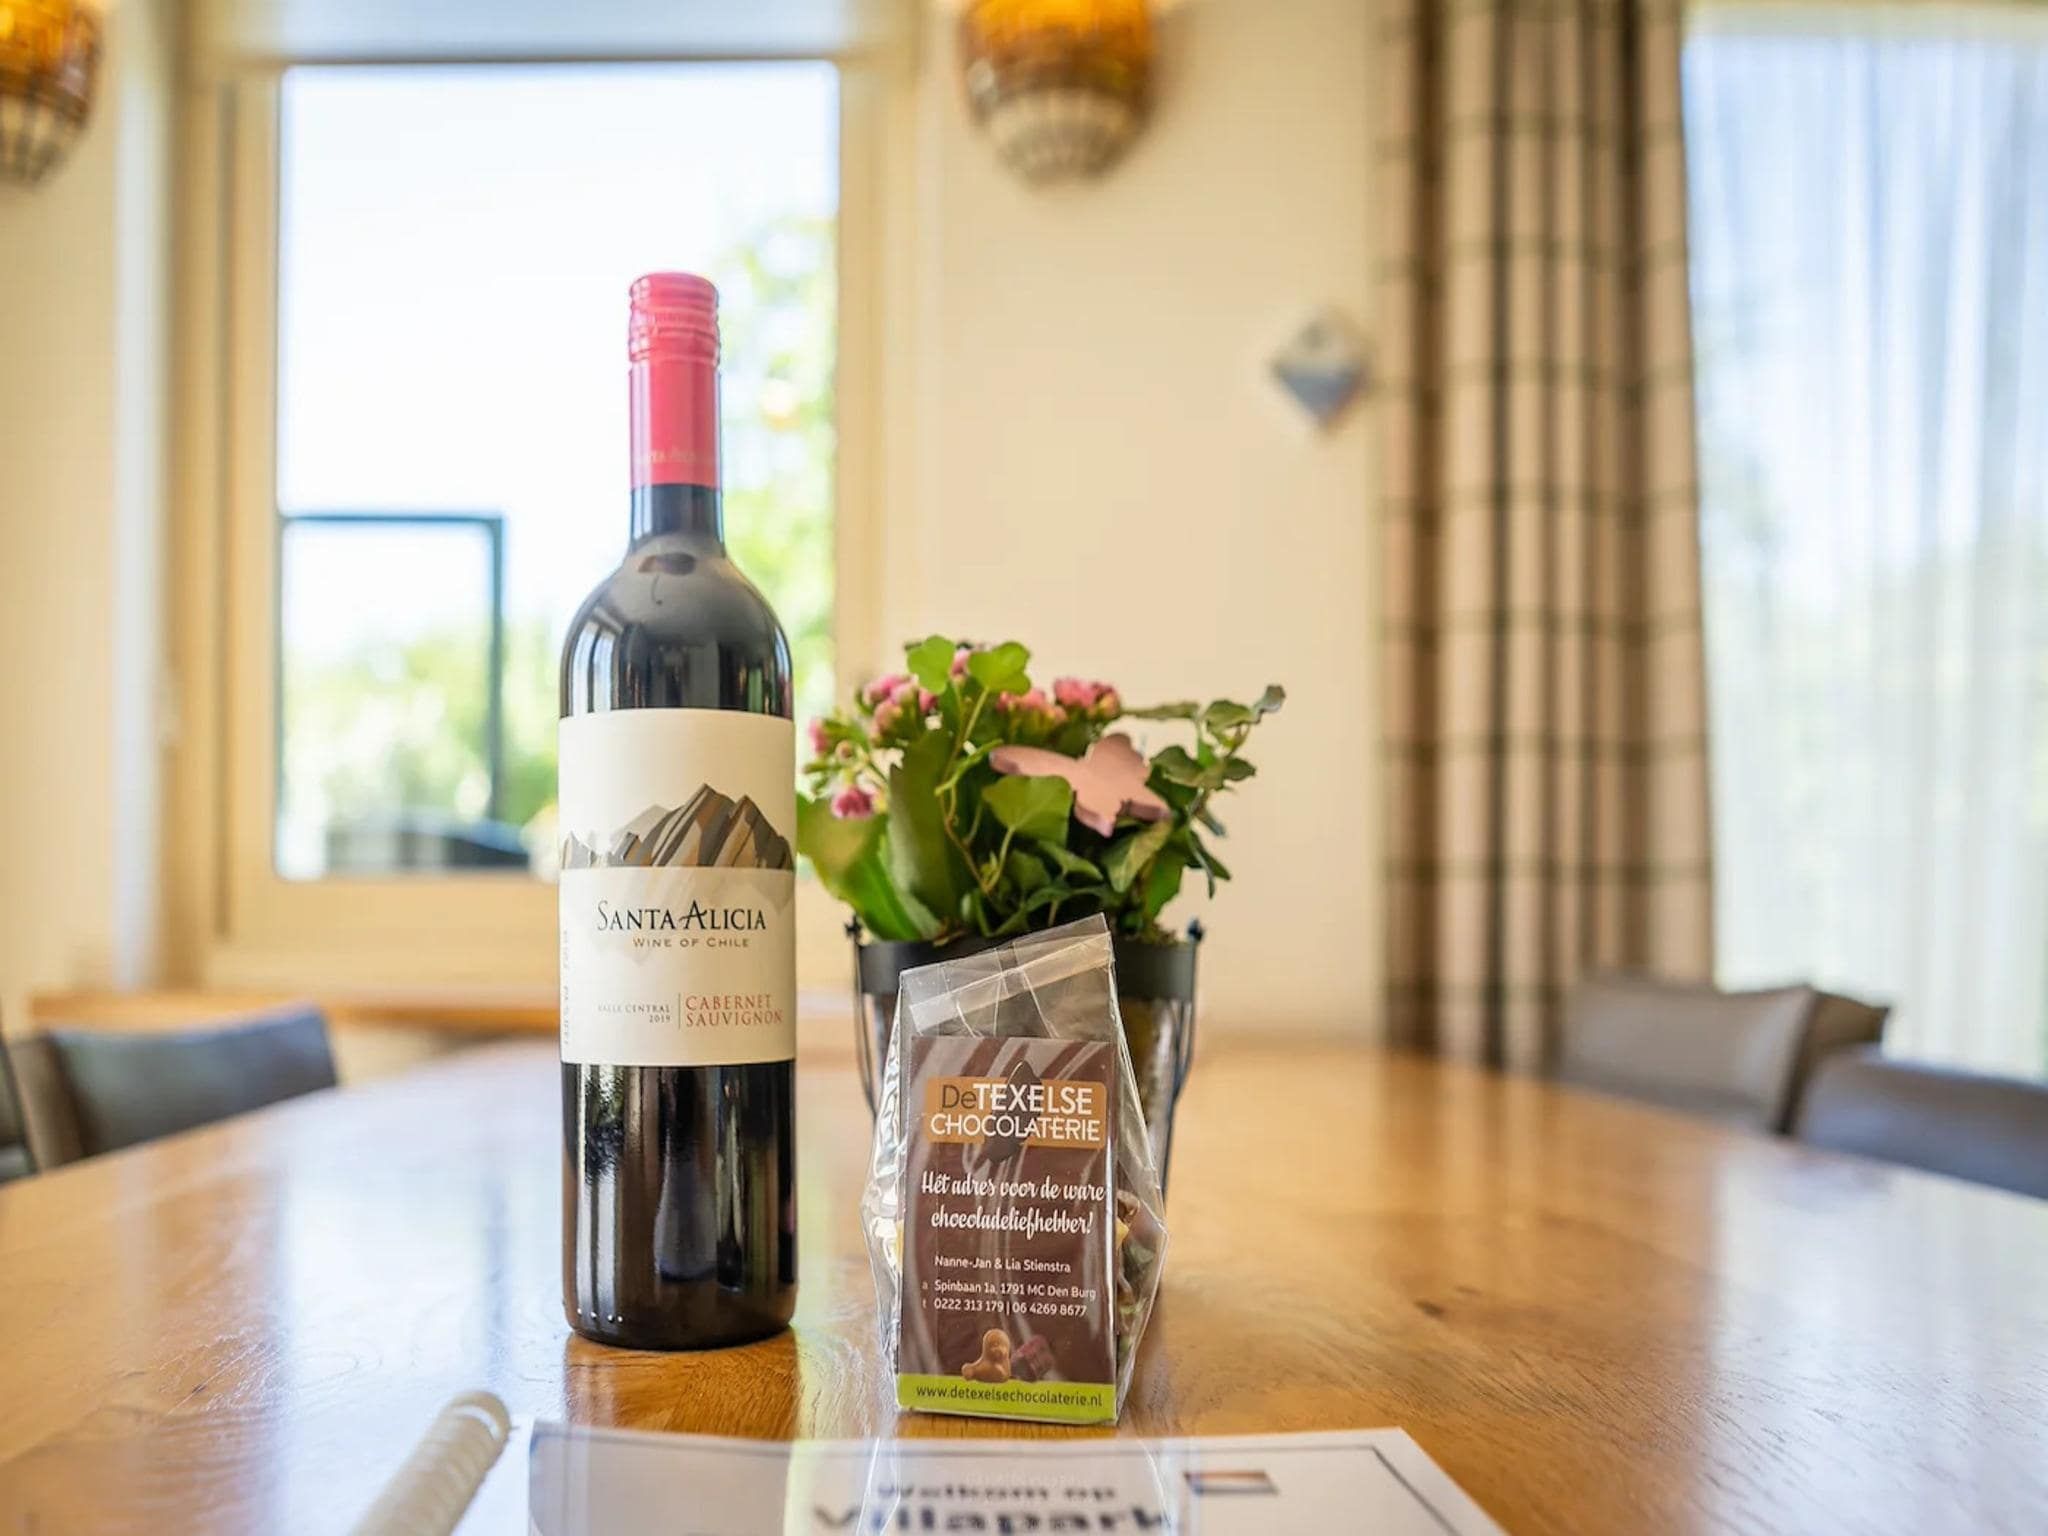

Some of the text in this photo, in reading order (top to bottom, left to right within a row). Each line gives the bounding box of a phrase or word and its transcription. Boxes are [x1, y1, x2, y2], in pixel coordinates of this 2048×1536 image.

[597, 899, 767, 931] SANTA ALICIA
[633, 937, 750, 948] WINE OF CHILE
[624, 1003, 671, 1013] CENTRAL
[685, 993, 772, 1012] CABERNET
[685, 1009, 783, 1028] SAUVIGNON
[930, 1112, 1101, 1142] CHOCOLATERIE
[952, 1173, 995, 1196] adres
[1000, 1180, 1039, 1197] voor
[1040, 1176, 1062, 1200] de
[1063, 1183, 1106, 1201] ware
[930, 1205, 1094, 1241] chocoladeliefhebber!
[934, 1255, 1071, 1274] Nanne-Jan & Lia Stienstra
[934, 1280, 982, 1295] Spinbaan
[1000, 1283, 1025, 1295] 1791
[1027, 1284, 1045, 1296] MC
[1047, 1285, 1069, 1298] Den
[1071, 1286, 1097, 1302] Burg
[934, 1298, 962, 1311] 0222
[963, 1300, 983, 1311] 313
[986, 1300, 1004, 1312] 179
[1012, 1302, 1027, 1314] 06
[1029, 1303, 1057, 1315] 4269
[1060, 1304, 1087, 1317] 8677
[916, 1384, 1103, 1407] www.detexelsechocolaterie.nl
